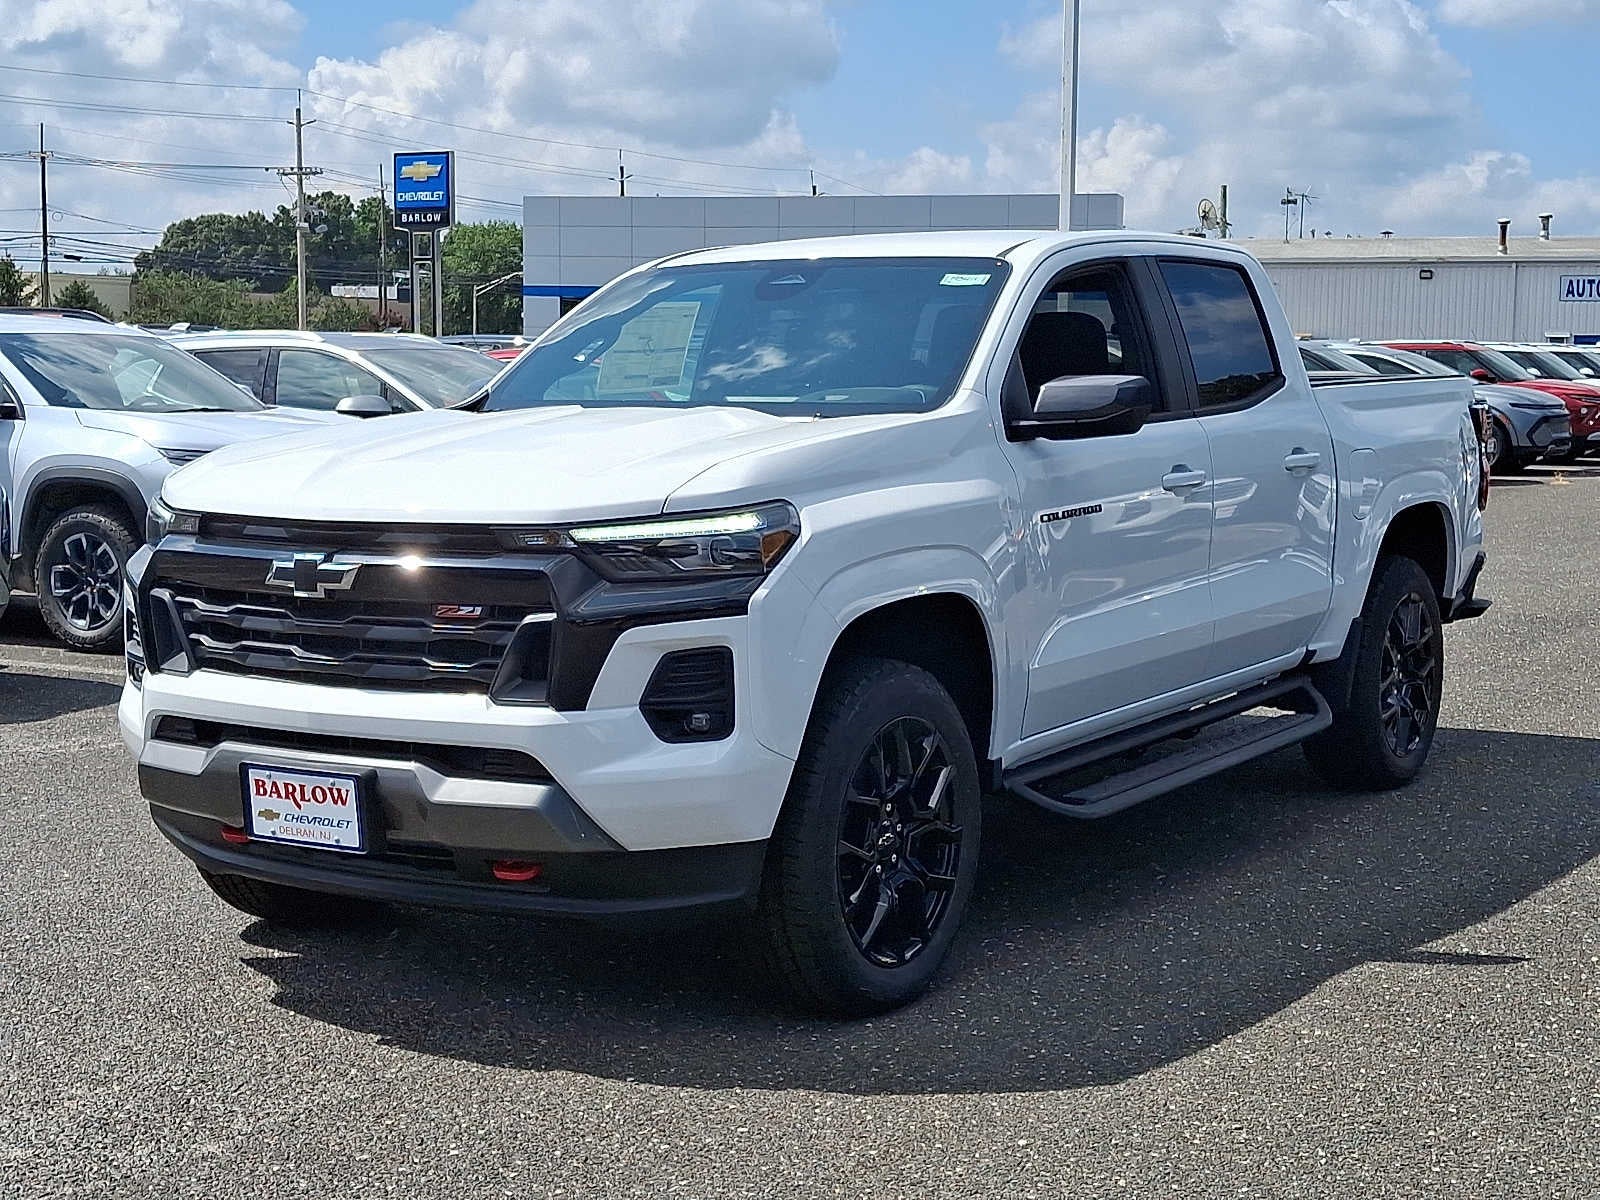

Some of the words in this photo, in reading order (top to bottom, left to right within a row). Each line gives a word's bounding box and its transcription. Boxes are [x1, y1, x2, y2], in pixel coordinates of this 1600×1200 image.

[397, 191, 444, 202] CHEVROLET
[401, 213, 441, 223] BARLOW
[1040, 504, 1103, 523] COLORADO
[435, 604, 482, 617] Z71
[254, 778, 351, 811] BARLOW
[284, 813, 353, 829] CHEVROLET
[319, 830, 331, 841] NJ
